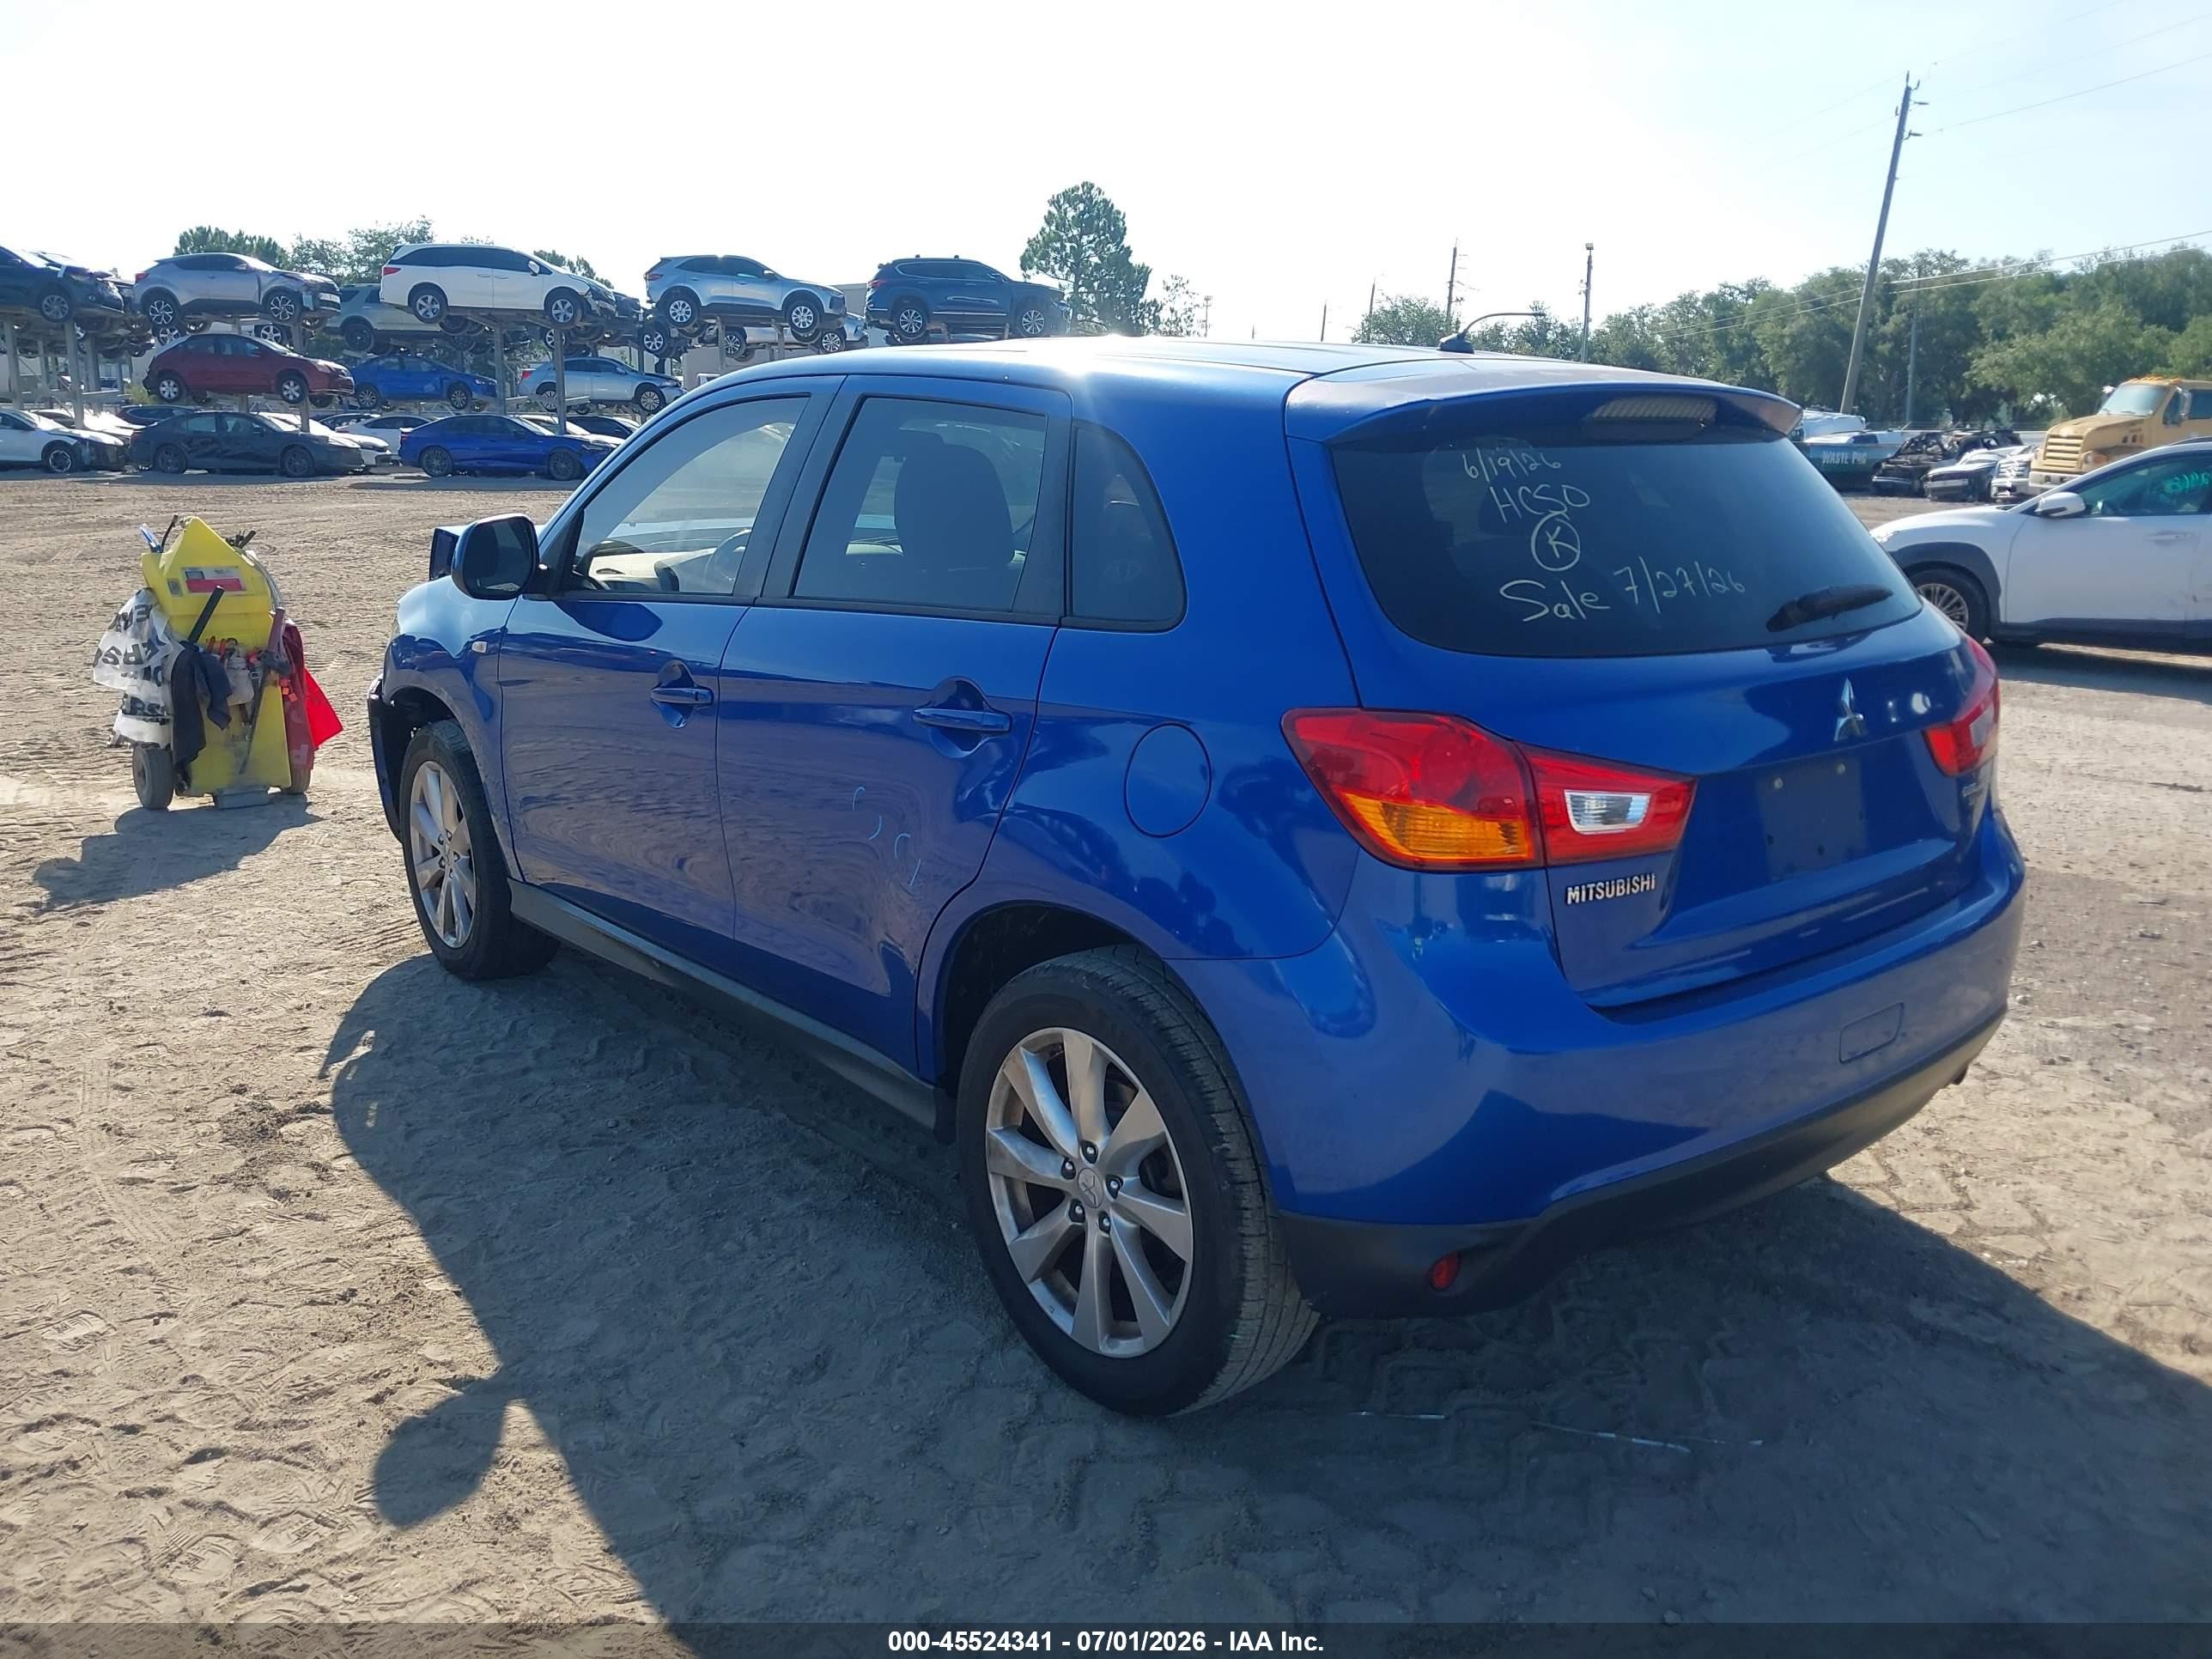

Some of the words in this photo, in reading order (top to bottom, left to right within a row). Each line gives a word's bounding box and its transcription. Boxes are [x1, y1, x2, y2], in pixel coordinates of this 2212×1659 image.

[1462, 447, 1562, 483] 6/19/26
[1499, 580, 1611, 622] Sale
[1613, 556, 1746, 613] 7/27/26
[1567, 872, 1656, 905] MITSUBISHI
